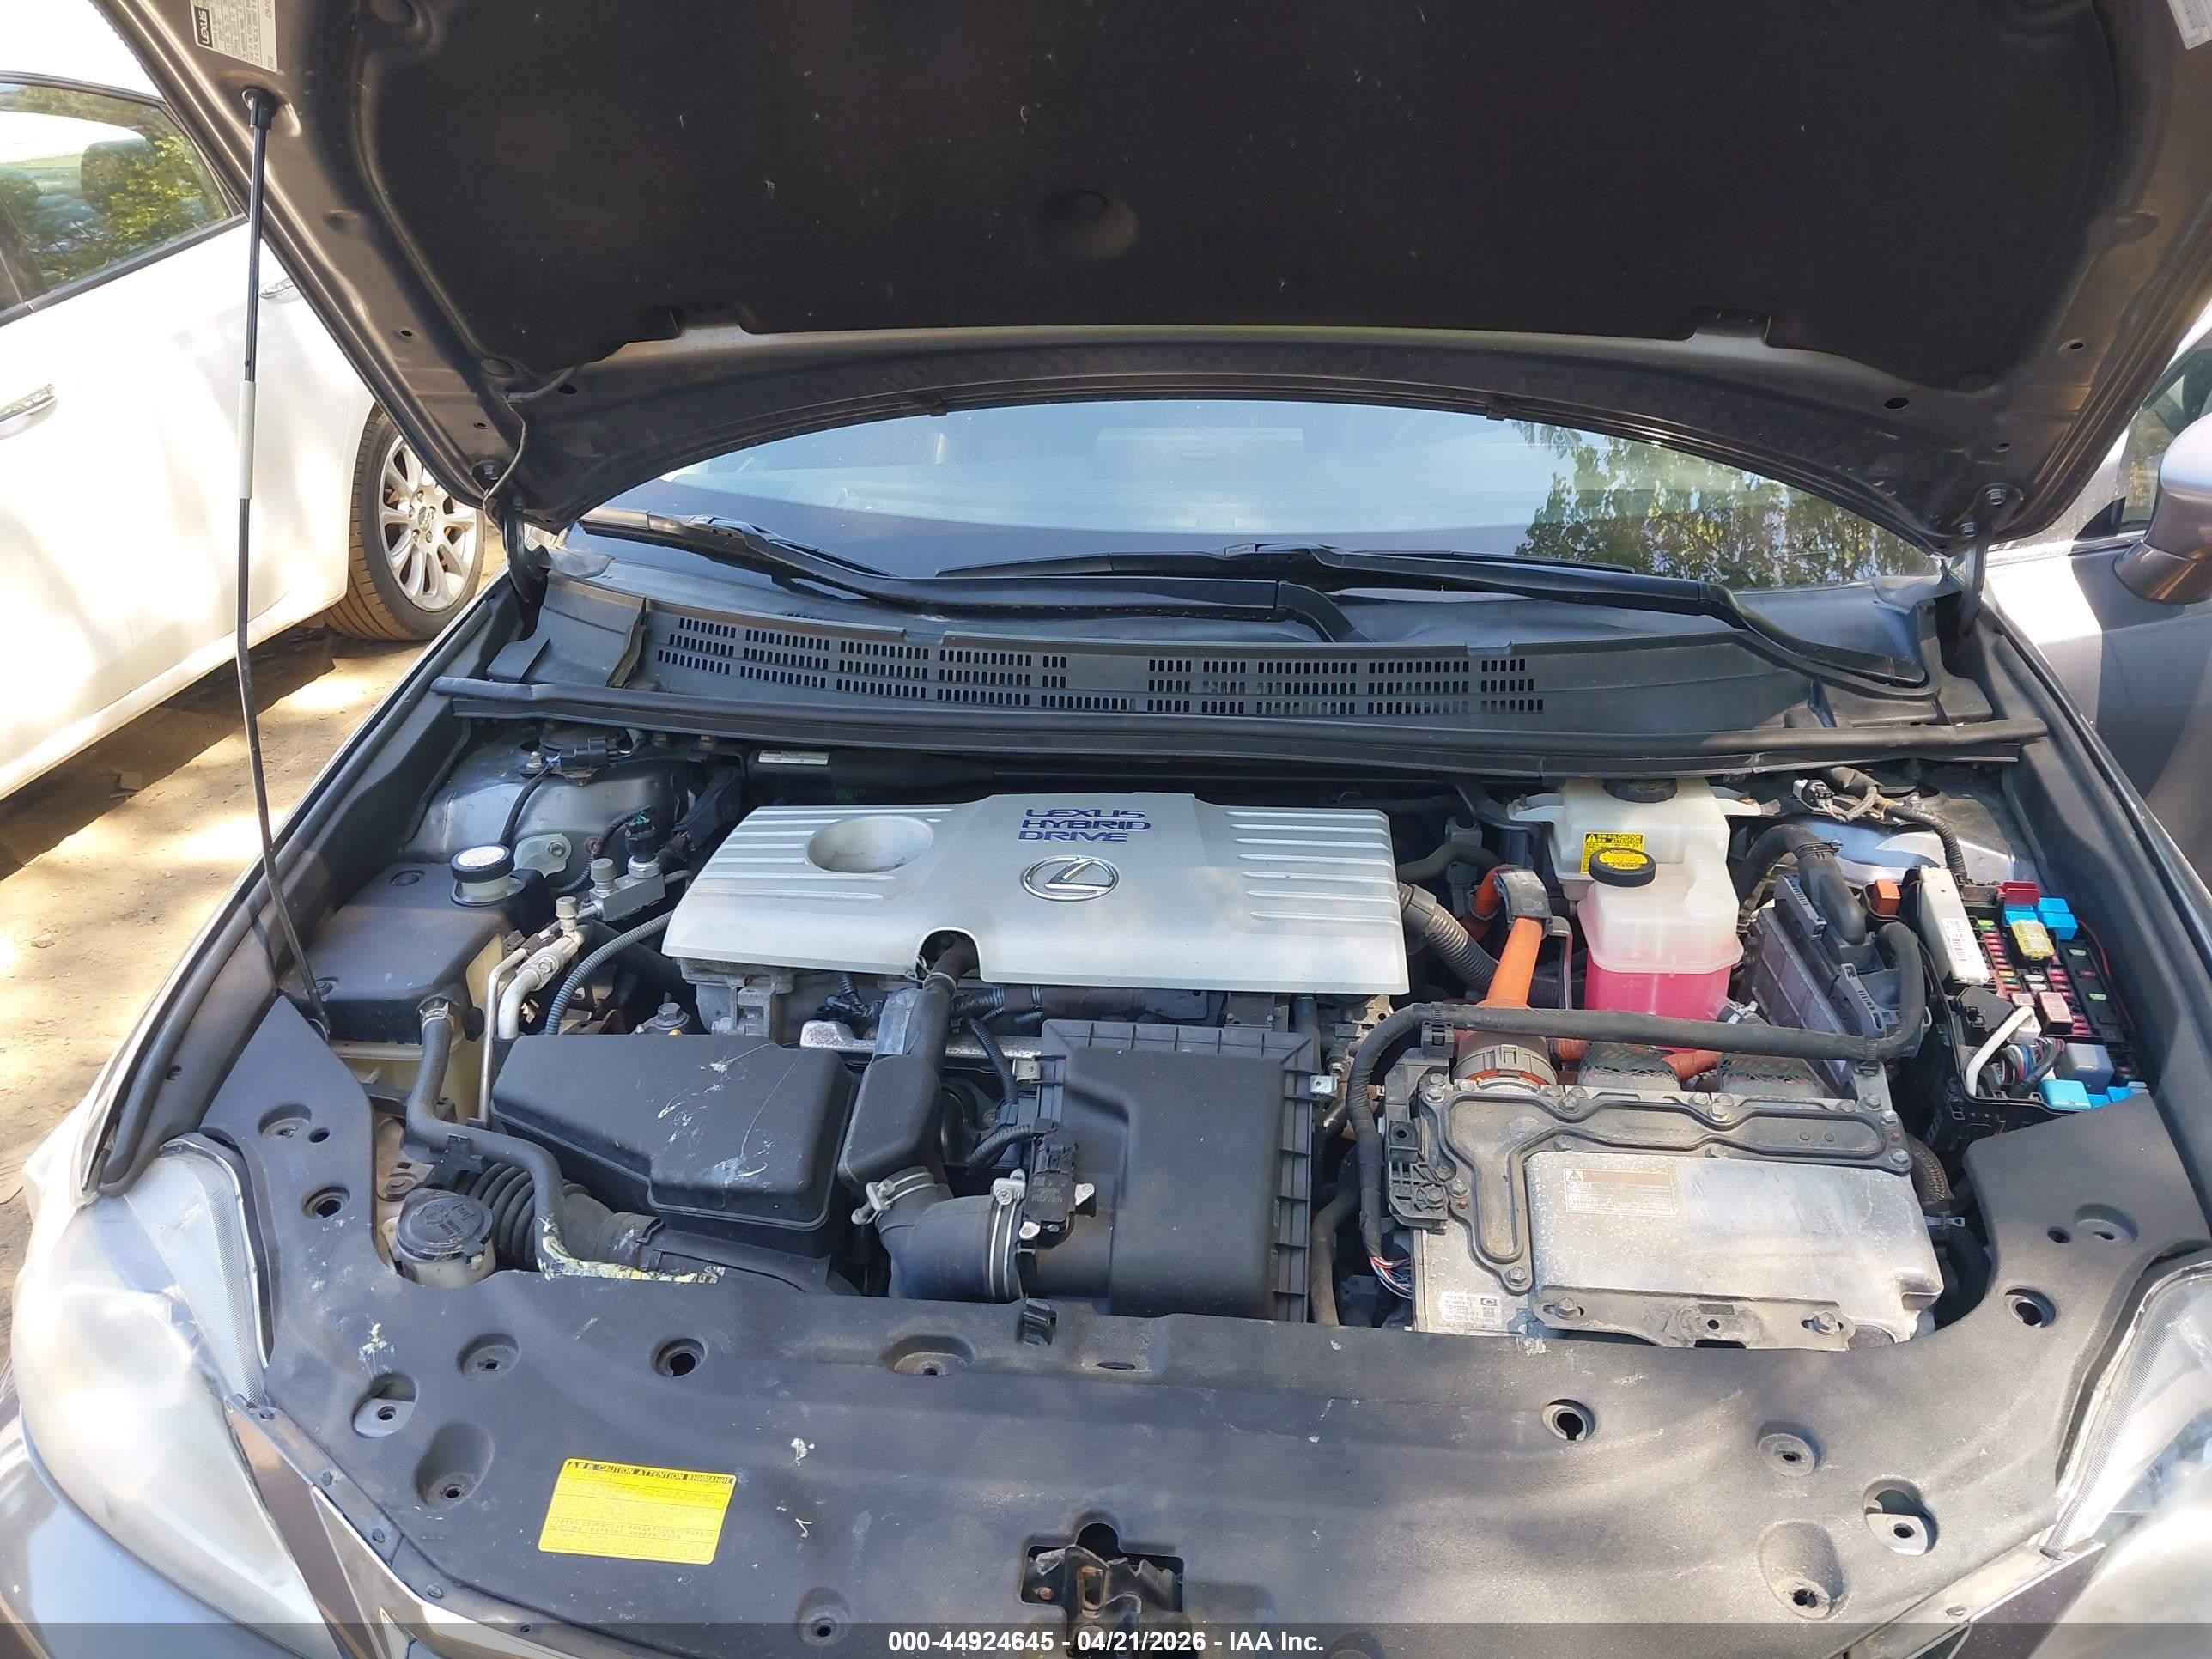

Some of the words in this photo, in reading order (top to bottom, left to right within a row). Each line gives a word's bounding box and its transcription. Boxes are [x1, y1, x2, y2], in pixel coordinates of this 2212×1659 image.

[198, 9, 210, 45] LEXUS
[1025, 809, 1146, 818] LEXUS
[1021, 819, 1152, 830] HYBRID
[1018, 830, 1129, 842] DRIVE
[597, 1464, 635, 1474] CAUTION
[637, 1469, 684, 1480] ATTENTION
